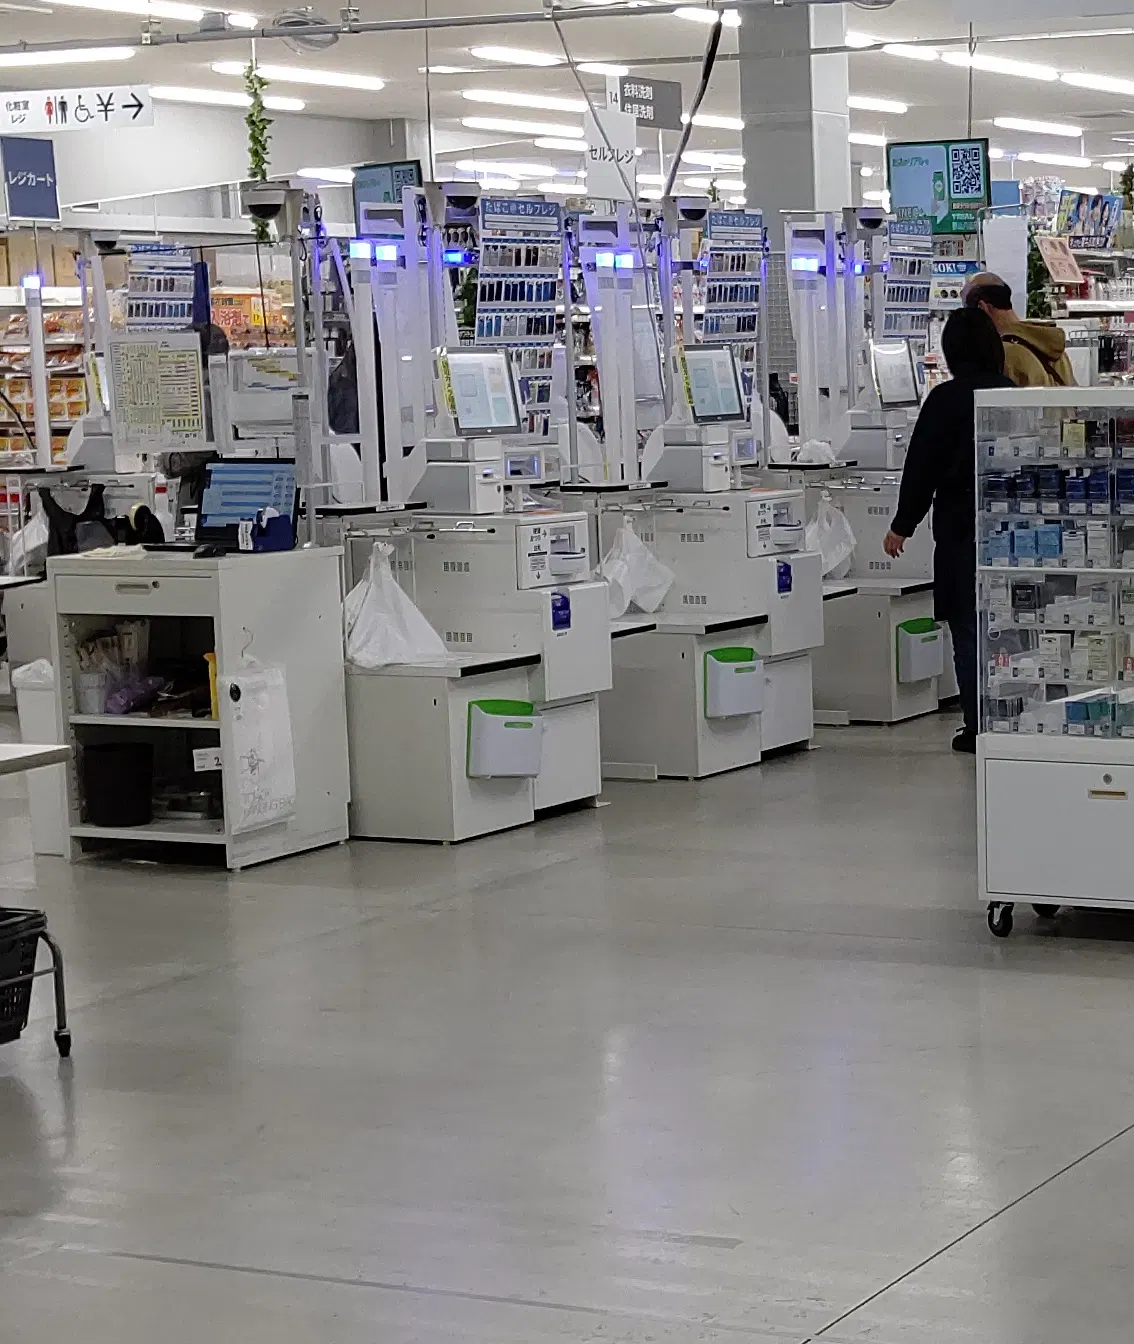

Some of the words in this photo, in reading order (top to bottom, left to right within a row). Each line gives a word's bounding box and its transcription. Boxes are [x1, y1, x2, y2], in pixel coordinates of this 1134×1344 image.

[609, 91, 619, 104] 14
[5, 100, 30, 111] 化粧室
[11, 114, 28, 124] レジ
[589, 145, 634, 164] セルフレジ
[8, 171, 54, 187] レジカート
